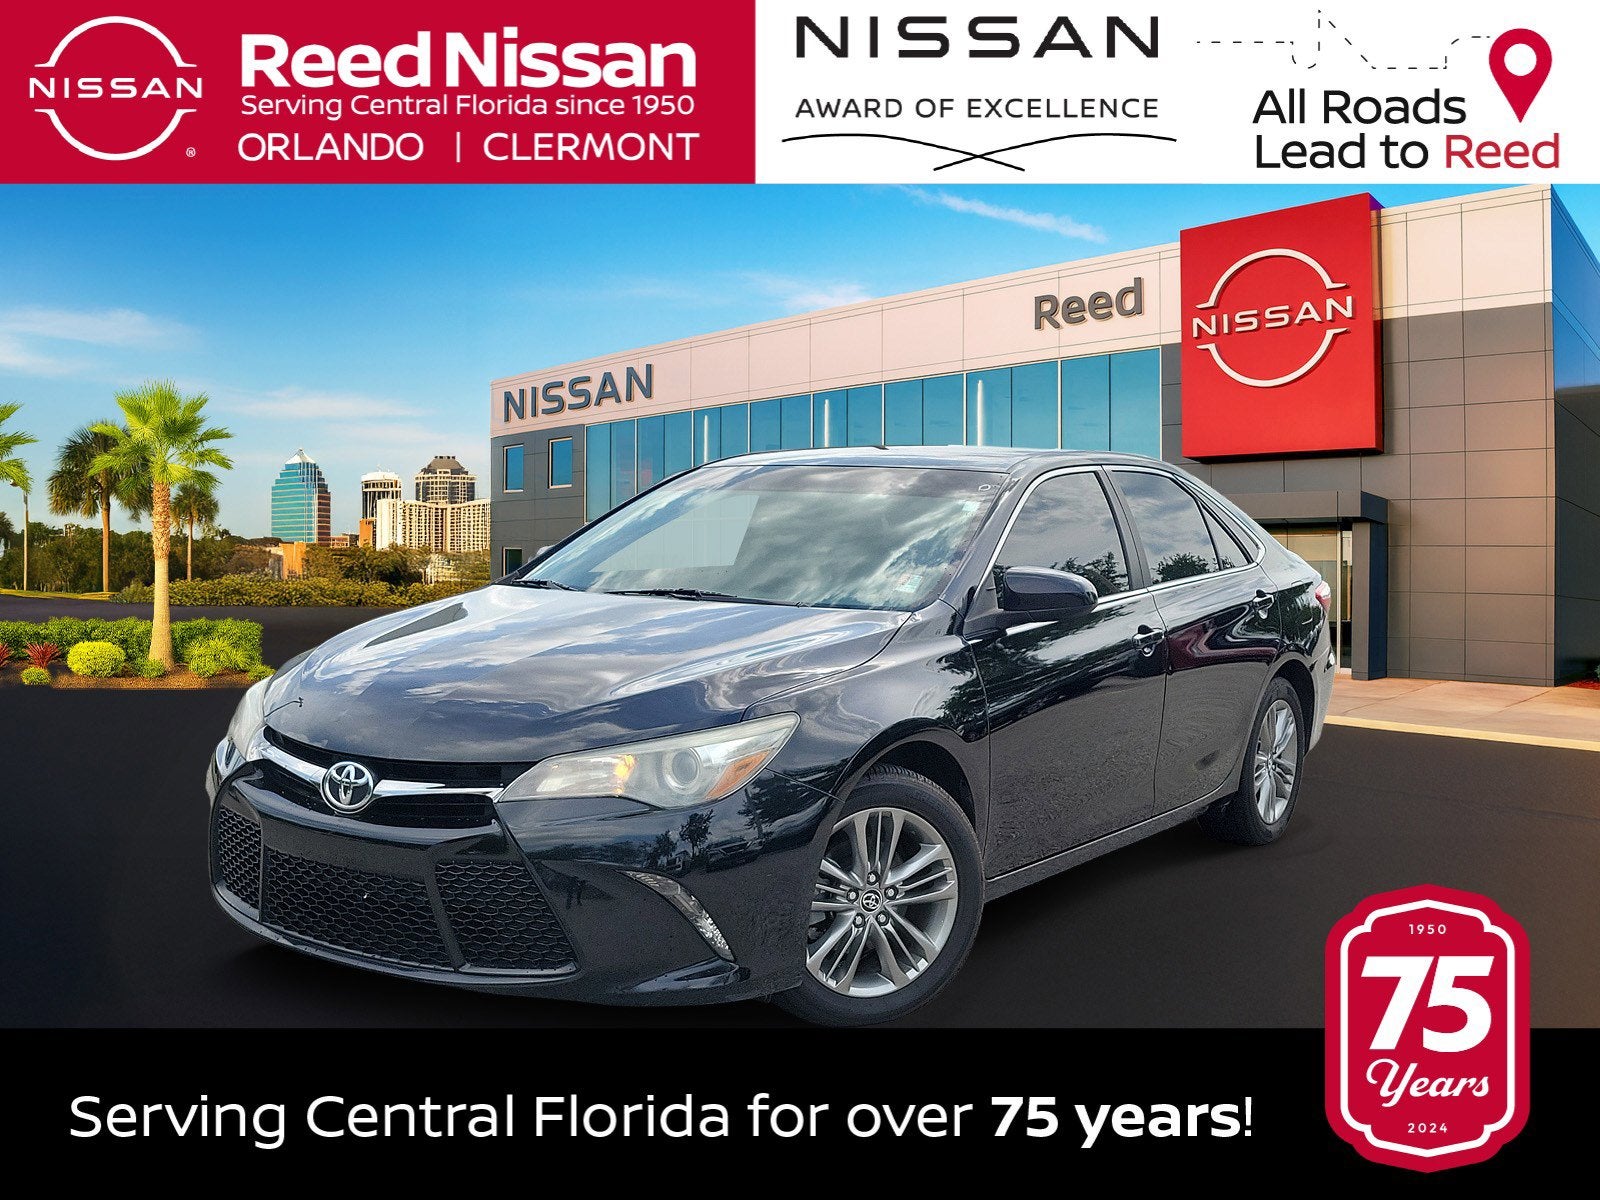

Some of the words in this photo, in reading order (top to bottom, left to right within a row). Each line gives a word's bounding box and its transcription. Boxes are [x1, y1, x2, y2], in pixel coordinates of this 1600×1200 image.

[1034, 277, 1144, 330] Reed
[1192, 296, 1353, 338] NISSAN
[503, 364, 653, 422] NISSAN
